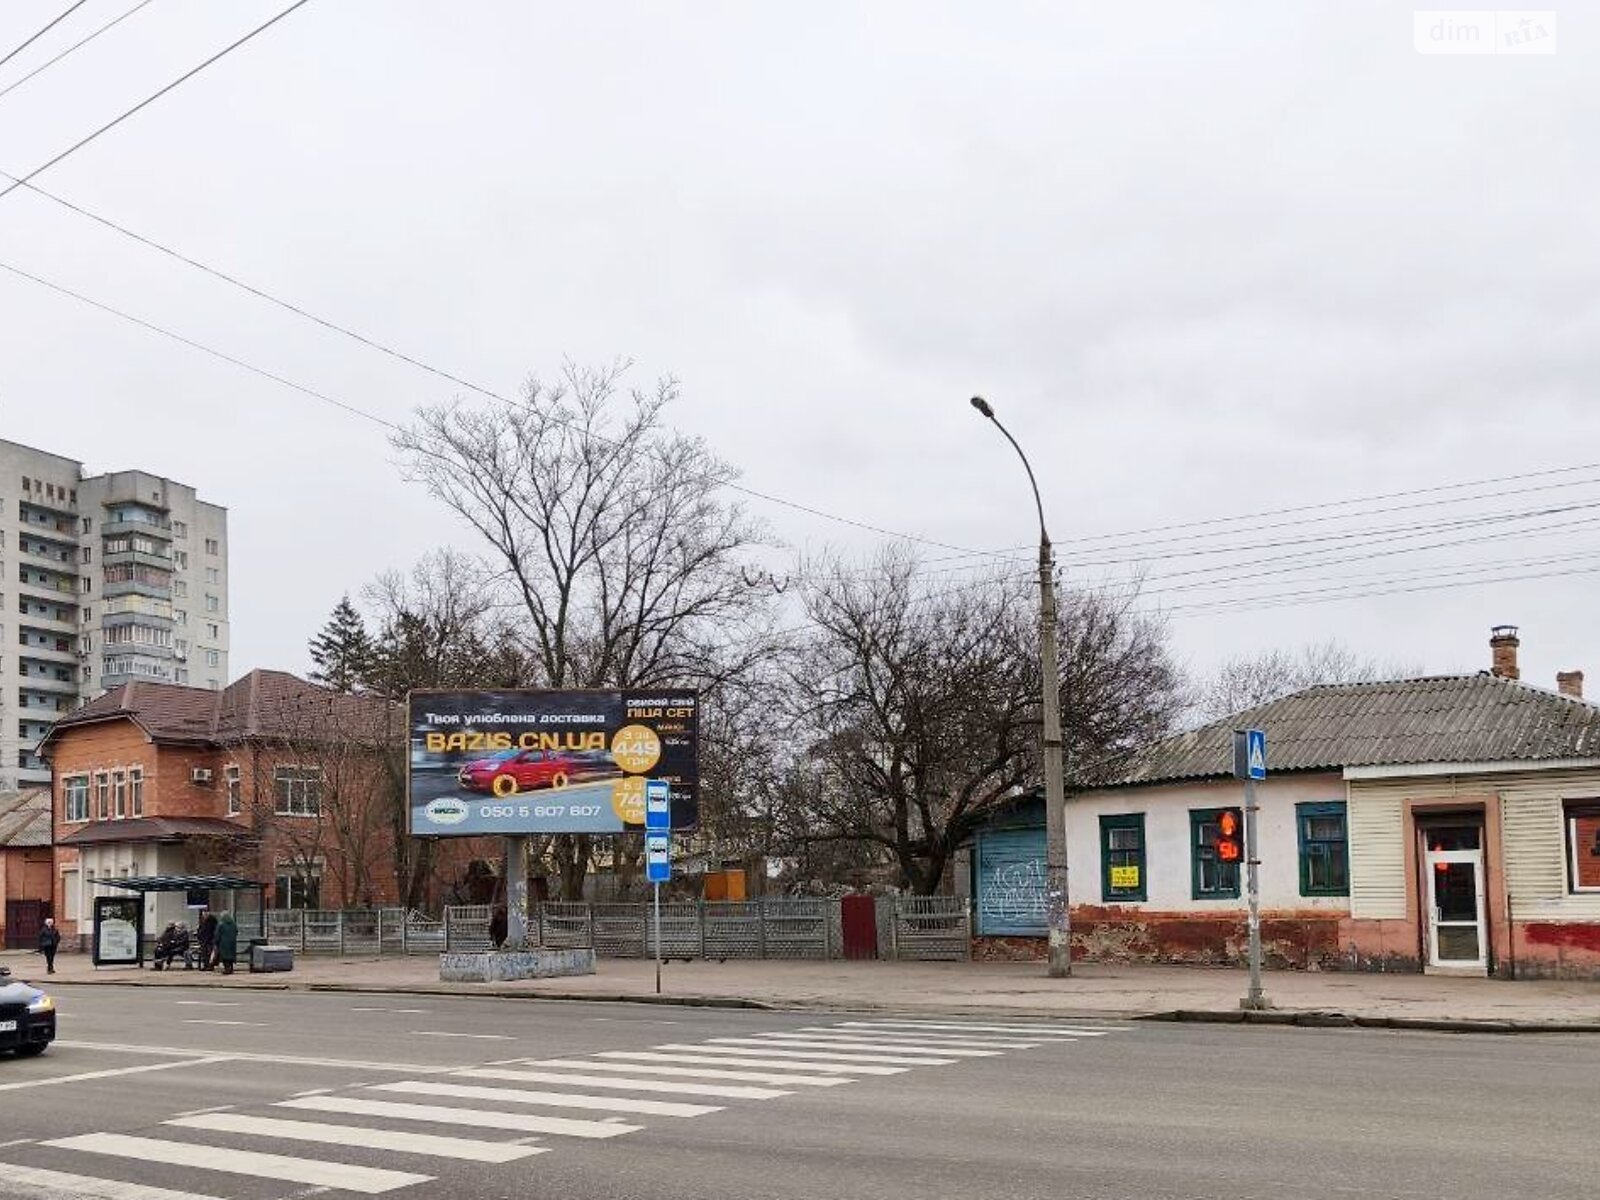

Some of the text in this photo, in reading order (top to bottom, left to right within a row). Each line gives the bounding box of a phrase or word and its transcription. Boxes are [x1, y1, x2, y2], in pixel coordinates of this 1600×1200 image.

[425, 713, 606, 726] Твоя улюблена доставка
[666, 708, 694, 718] СЕТ
[426, 732, 606, 752] BAZIS.CN.UA
[613, 741, 661, 756] 449
[480, 806, 513, 818] 050
[519, 806, 530, 818] 5
[534, 806, 565, 817] 607
